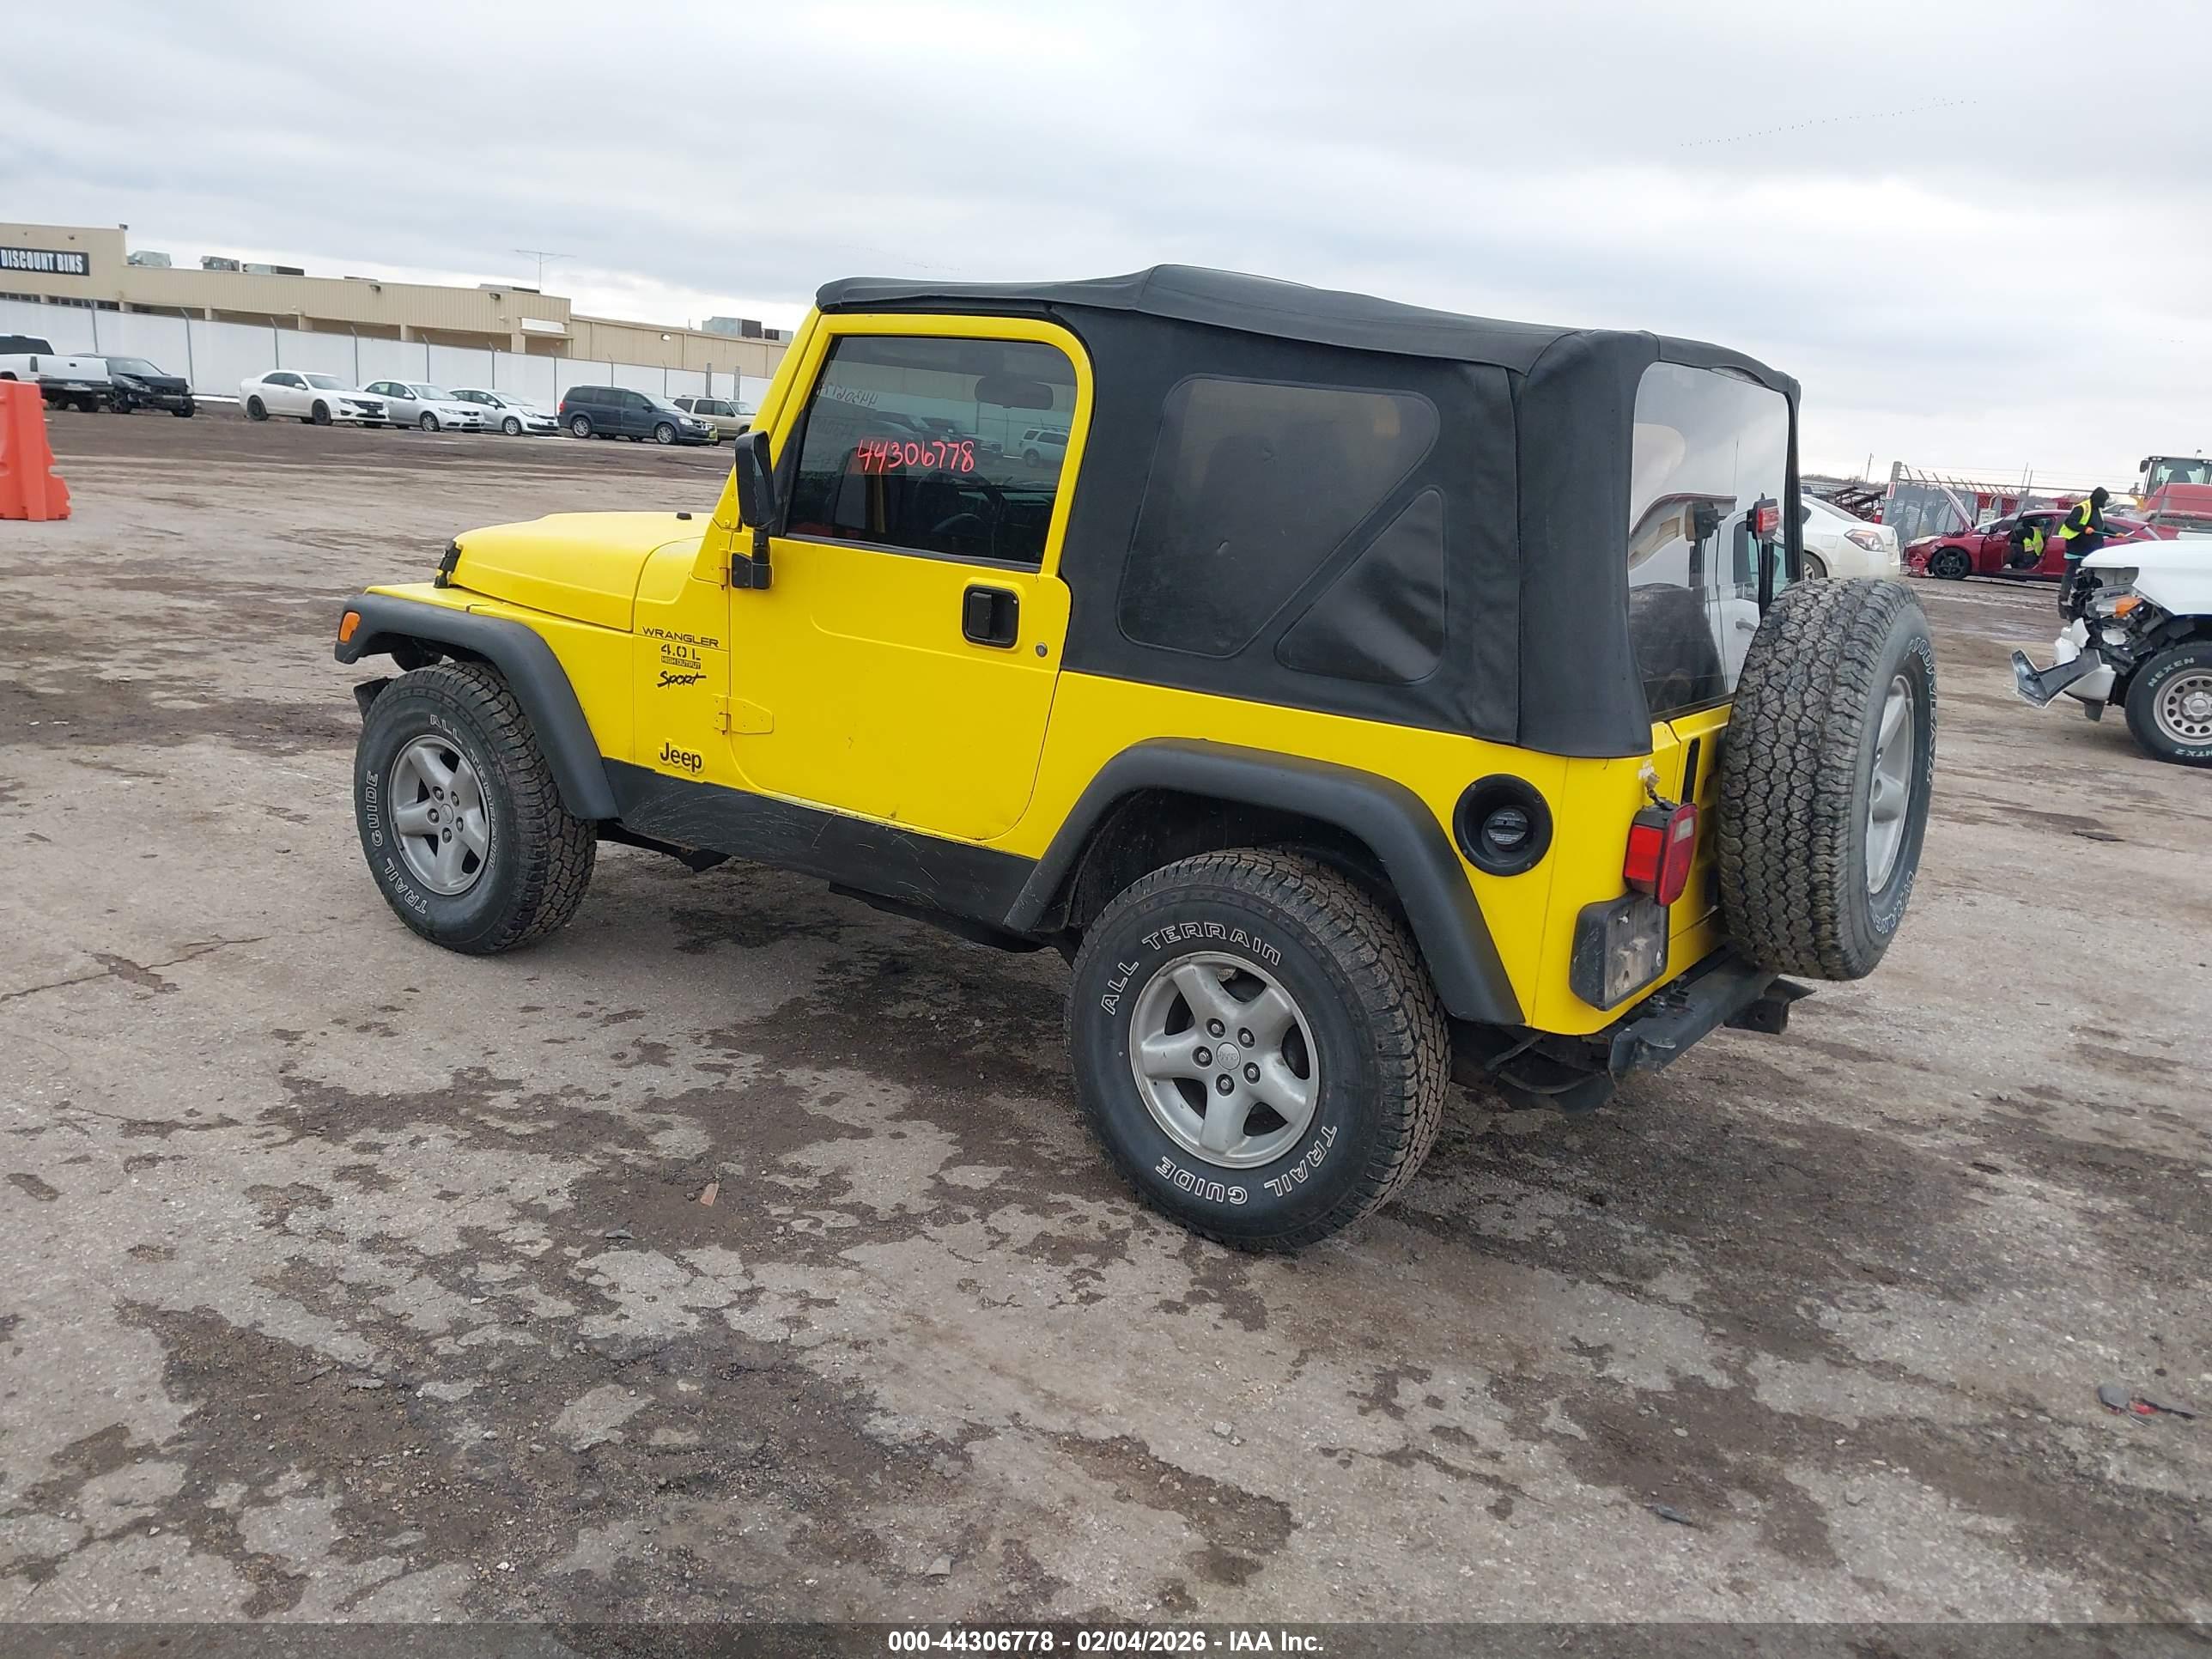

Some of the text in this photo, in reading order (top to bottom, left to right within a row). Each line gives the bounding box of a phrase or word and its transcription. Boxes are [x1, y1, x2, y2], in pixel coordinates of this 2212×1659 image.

[1, 249, 83, 273] DISCOUNT BINS
[858, 439, 975, 473] 44306778
[642, 626, 719, 647] WRANGLER
[661, 656, 701, 669] HIGH OUTPUT
[2148, 656, 2195, 687] NEXEN
[430, 714, 462, 744] ALL
[660, 742, 702, 773] Jeep
[365, 770, 428, 914] TRAIL GUIDE
[1100, 921, 1282, 1016] ALL TERRAIN
[1155, 1126, 1338, 1205] TRAIL GUIDE
